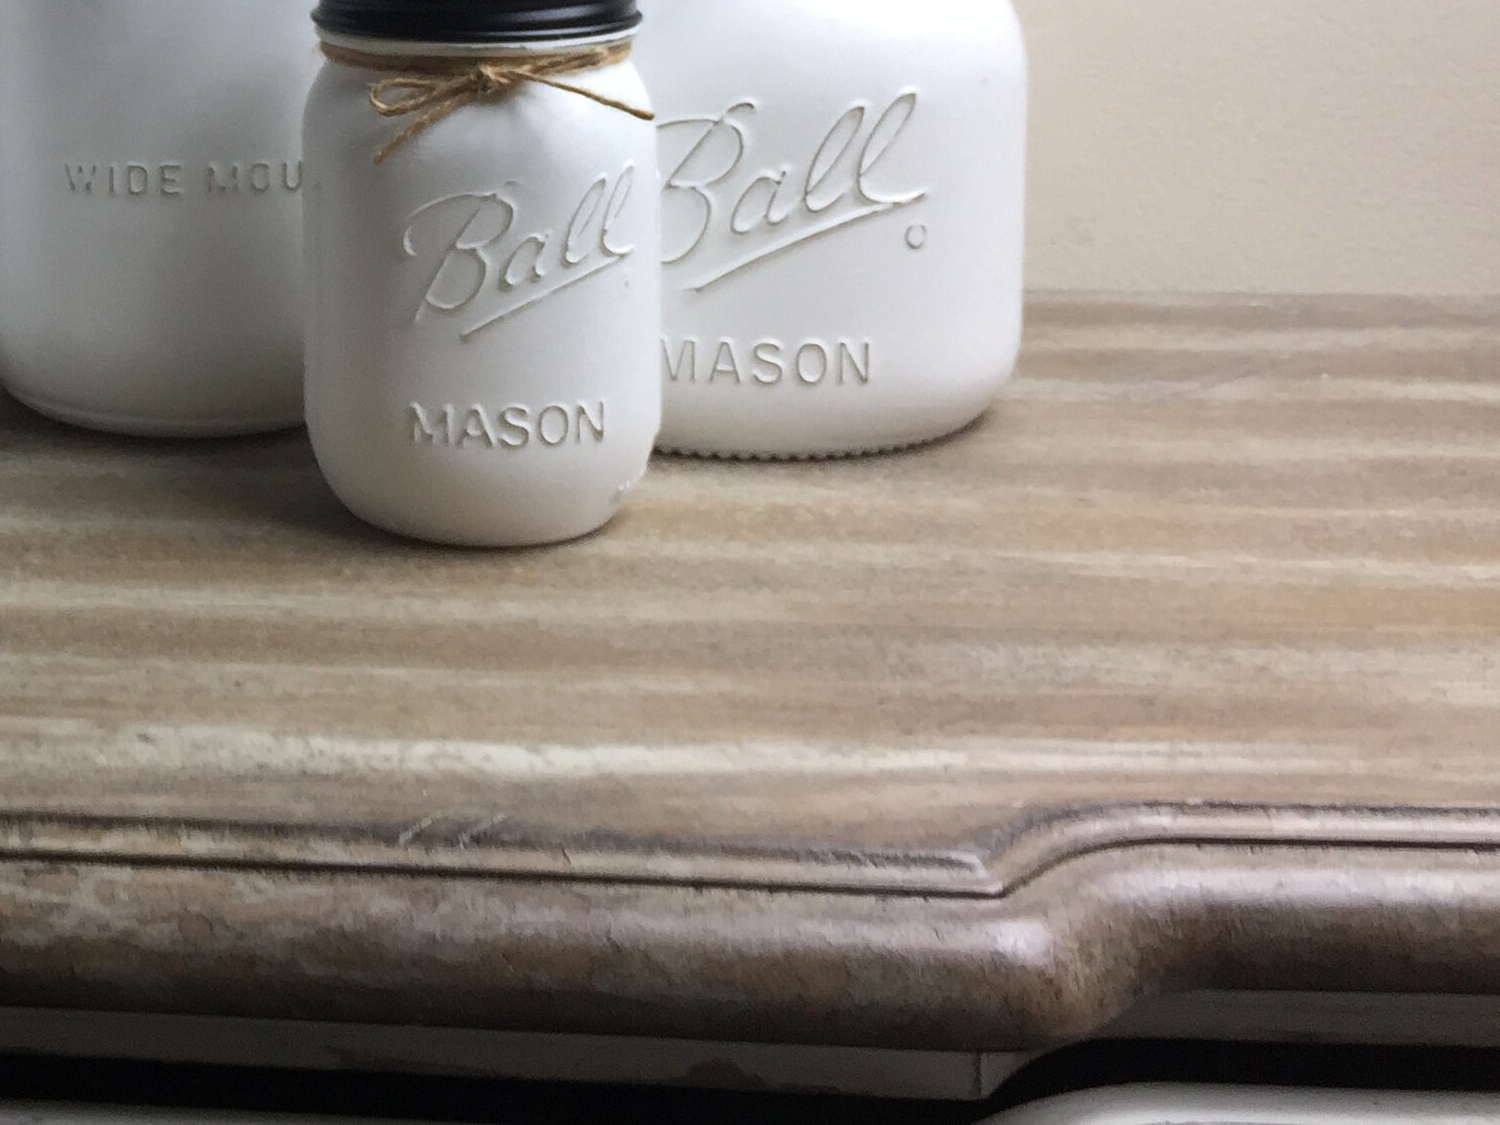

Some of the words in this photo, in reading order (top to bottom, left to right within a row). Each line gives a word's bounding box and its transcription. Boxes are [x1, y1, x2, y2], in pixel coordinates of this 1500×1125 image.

[64, 161, 182, 196] WIDE
[205, 161, 303, 195] MOU
[656, 86, 930, 293] Ball
[403, 166, 635, 342] Ball
[660, 338, 872, 387] MASON
[407, 400, 605, 449] MASON
